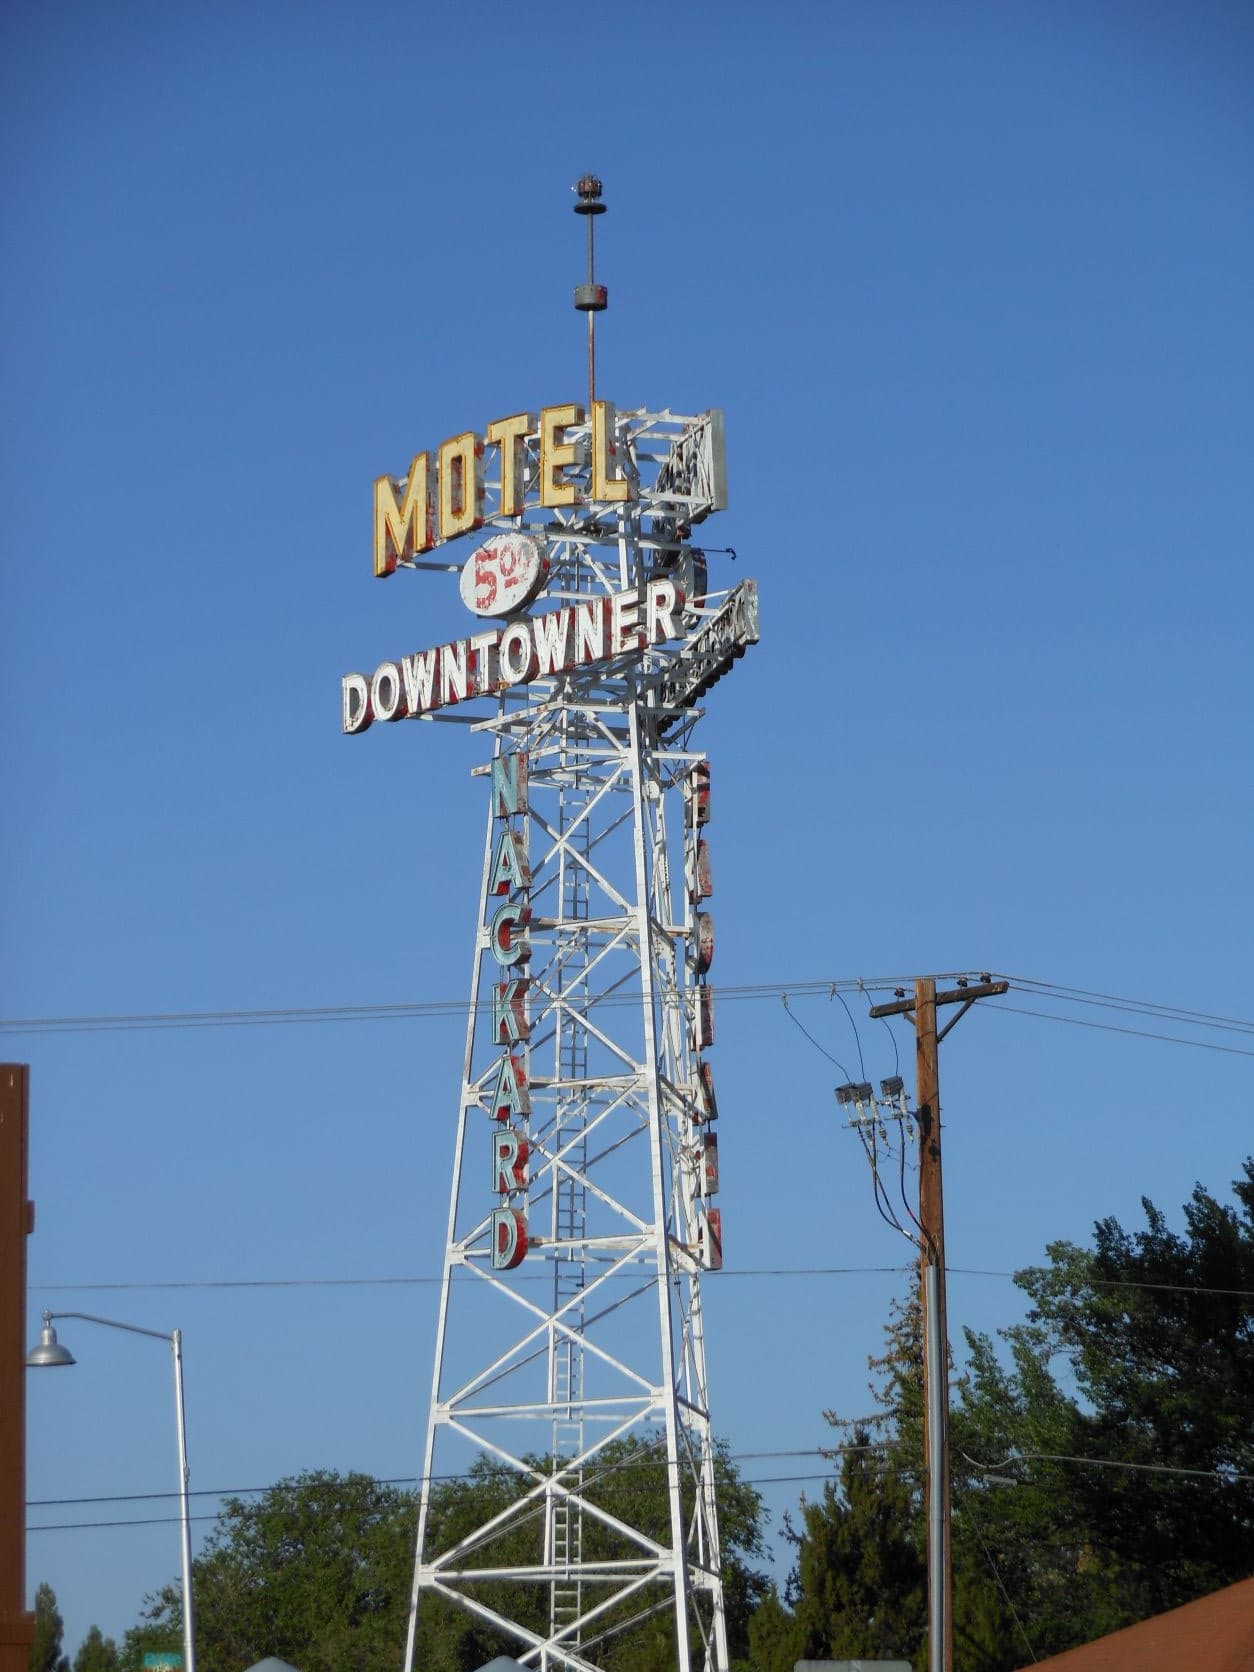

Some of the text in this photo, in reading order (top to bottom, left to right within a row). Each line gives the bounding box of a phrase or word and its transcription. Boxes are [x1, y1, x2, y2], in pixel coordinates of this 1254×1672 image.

[372, 400, 632, 578] MOTEL
[341, 578, 686, 734] DOWNTOWNER
[488, 752, 532, 1270] NACKARD
